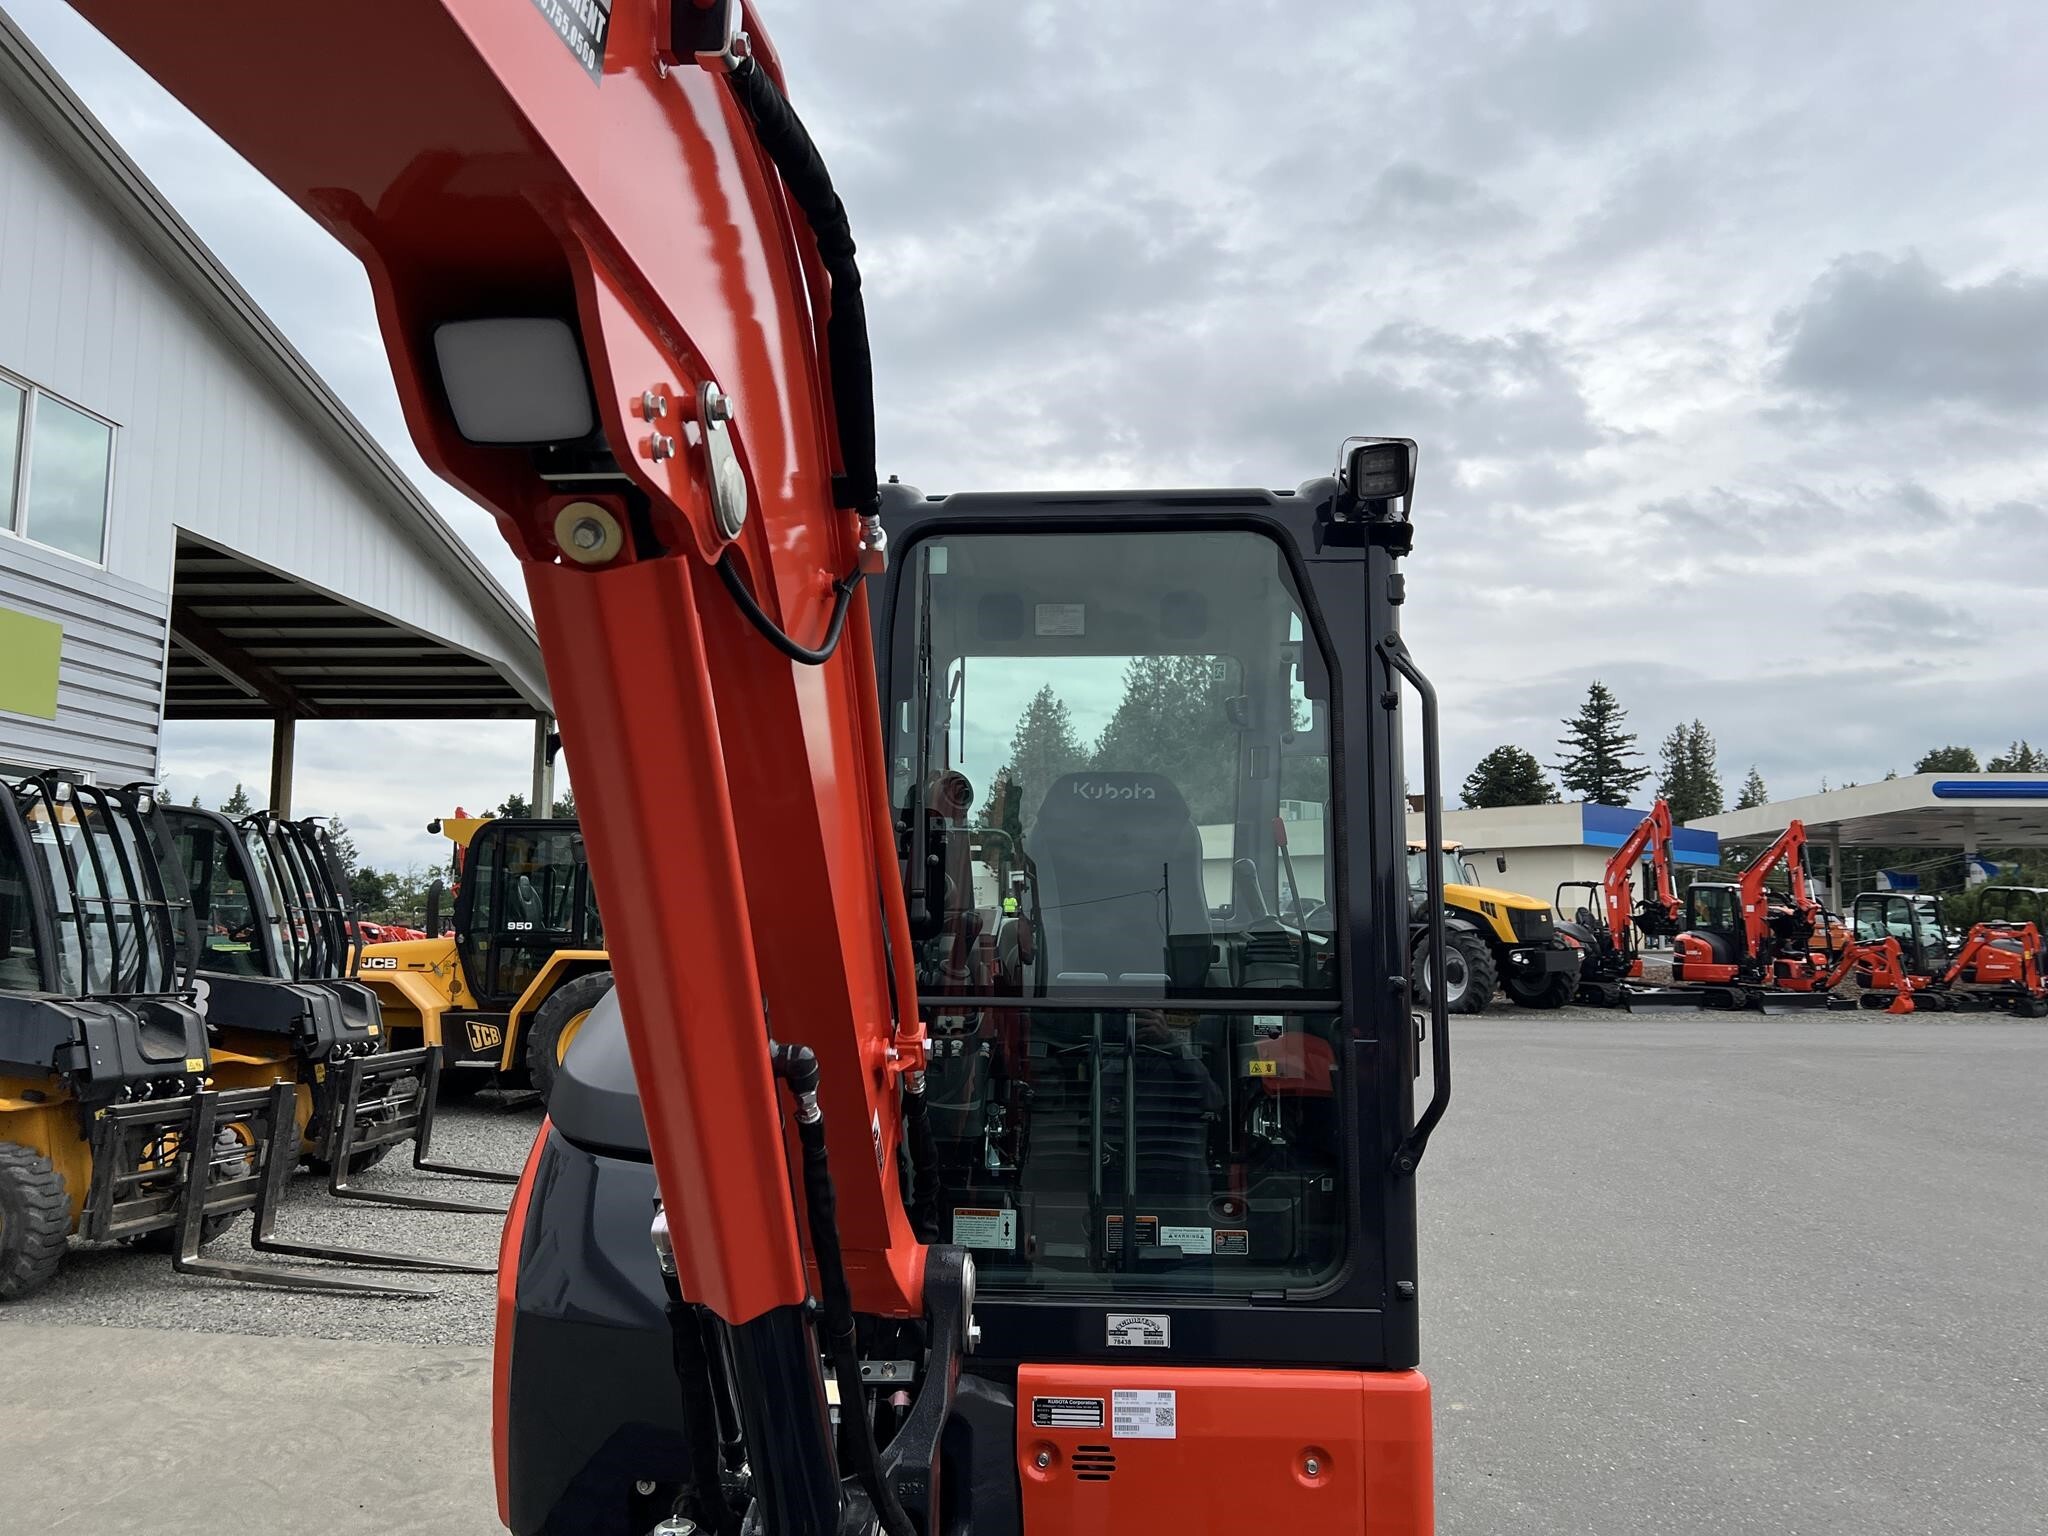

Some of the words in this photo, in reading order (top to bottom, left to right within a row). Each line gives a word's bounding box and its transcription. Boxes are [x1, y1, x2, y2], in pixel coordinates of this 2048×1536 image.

[1073, 781, 1156, 800] Kubota
[507, 922, 533, 930] 950
[361, 957, 397, 969] JCB
[471, 1024, 499, 1049] JCB
